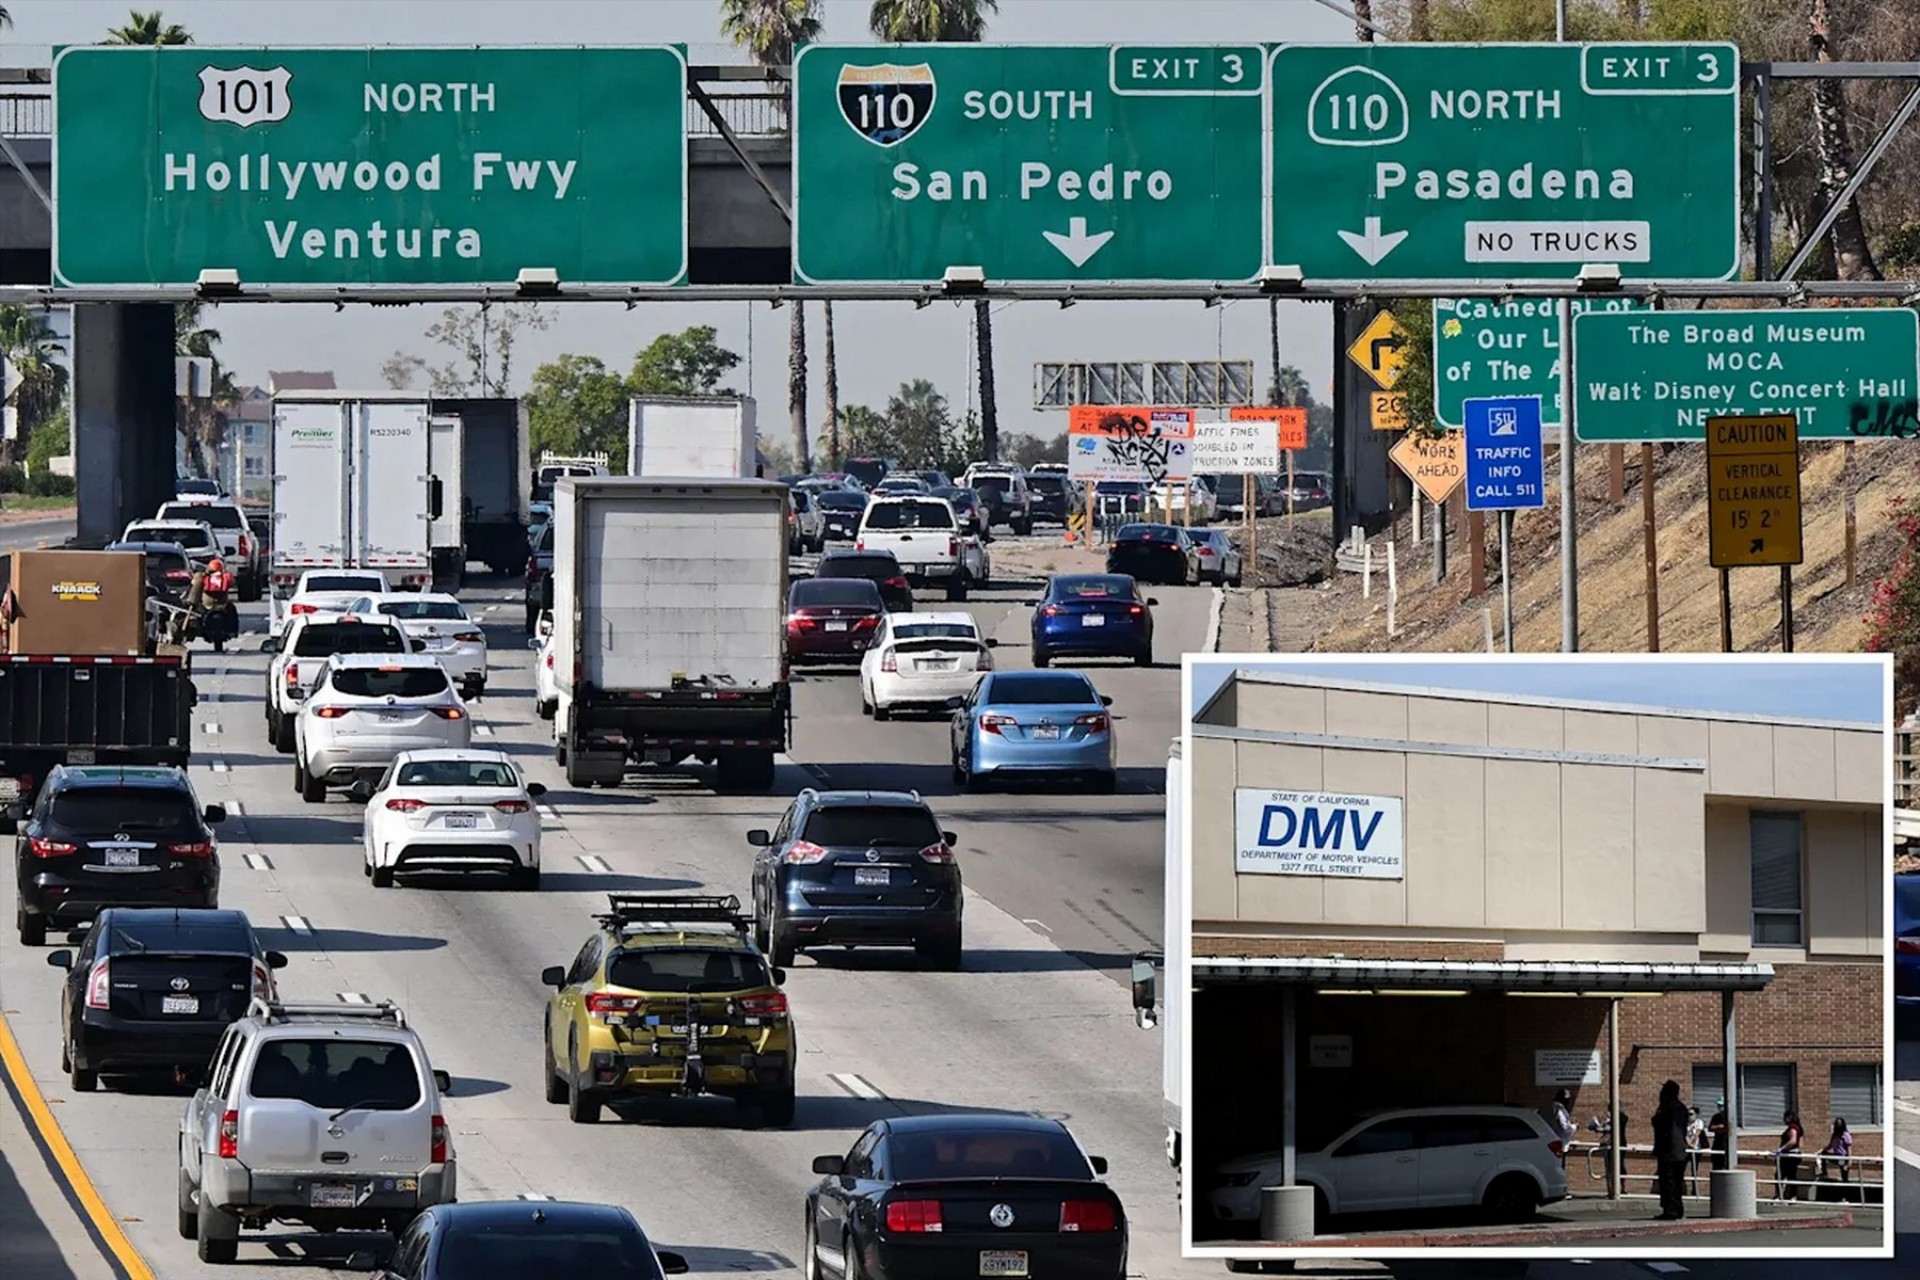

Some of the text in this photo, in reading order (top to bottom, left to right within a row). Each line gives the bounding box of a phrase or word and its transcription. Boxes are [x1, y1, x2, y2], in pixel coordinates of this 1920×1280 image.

[1132, 54, 1245, 83] EXIT 3
[1603, 54, 1718, 82] EXIT 3
[217, 80, 273, 114] 101
[364, 83, 495, 112] NORTH
[964, 90, 1092, 120] SOUTH
[1430, 89, 1561, 119] NORTH
[858, 92, 915, 129] 110
[1329, 94, 1389, 131] 110
[165, 152, 577, 201] Hollywood Fwy
[891, 162, 1173, 201] San Pedro
[1375, 162, 1634, 200] Pasadena
[264, 220, 482, 259] Ventura
[1478, 232, 1638, 252] NO TRUCKS
[1477, 328, 1528, 349] Our
[1628, 324, 1866, 344] The Broad Museum
[1446, 361, 1472, 381] of
[1487, 360, 1532, 381] The
[1707, 352, 1784, 371] MOCA
[1589, 379, 1905, 403] Walt Disney Concert Hall
[1495, 412, 1512, 427] 511
[1194, 427, 1260, 437] AFFIC FINES
[1717, 424, 1787, 444] CAUTION
[1194, 457, 1275, 467] TRUCTION ZONES
[1419, 445, 1457, 459] WORK
[1475, 446, 1532, 460] TRAFFIC
[1417, 464, 1459, 477] AHEAD
[1488, 465, 1522, 478] INFO
[1725, 463, 1782, 479] VERTICAL
[1475, 483, 1536, 498] CALL 511
[1718, 485, 1793, 501] CLEARANCE
[1271, 793, 1370, 806] STATE OF CALIFORNIA
[1257, 804, 1385, 851] DMV
[1240, 850, 1399, 866] DEPARTMENT OF MOTOR VEHICLES
[1280, 863, 1364, 875] 1377 FELL STREET
